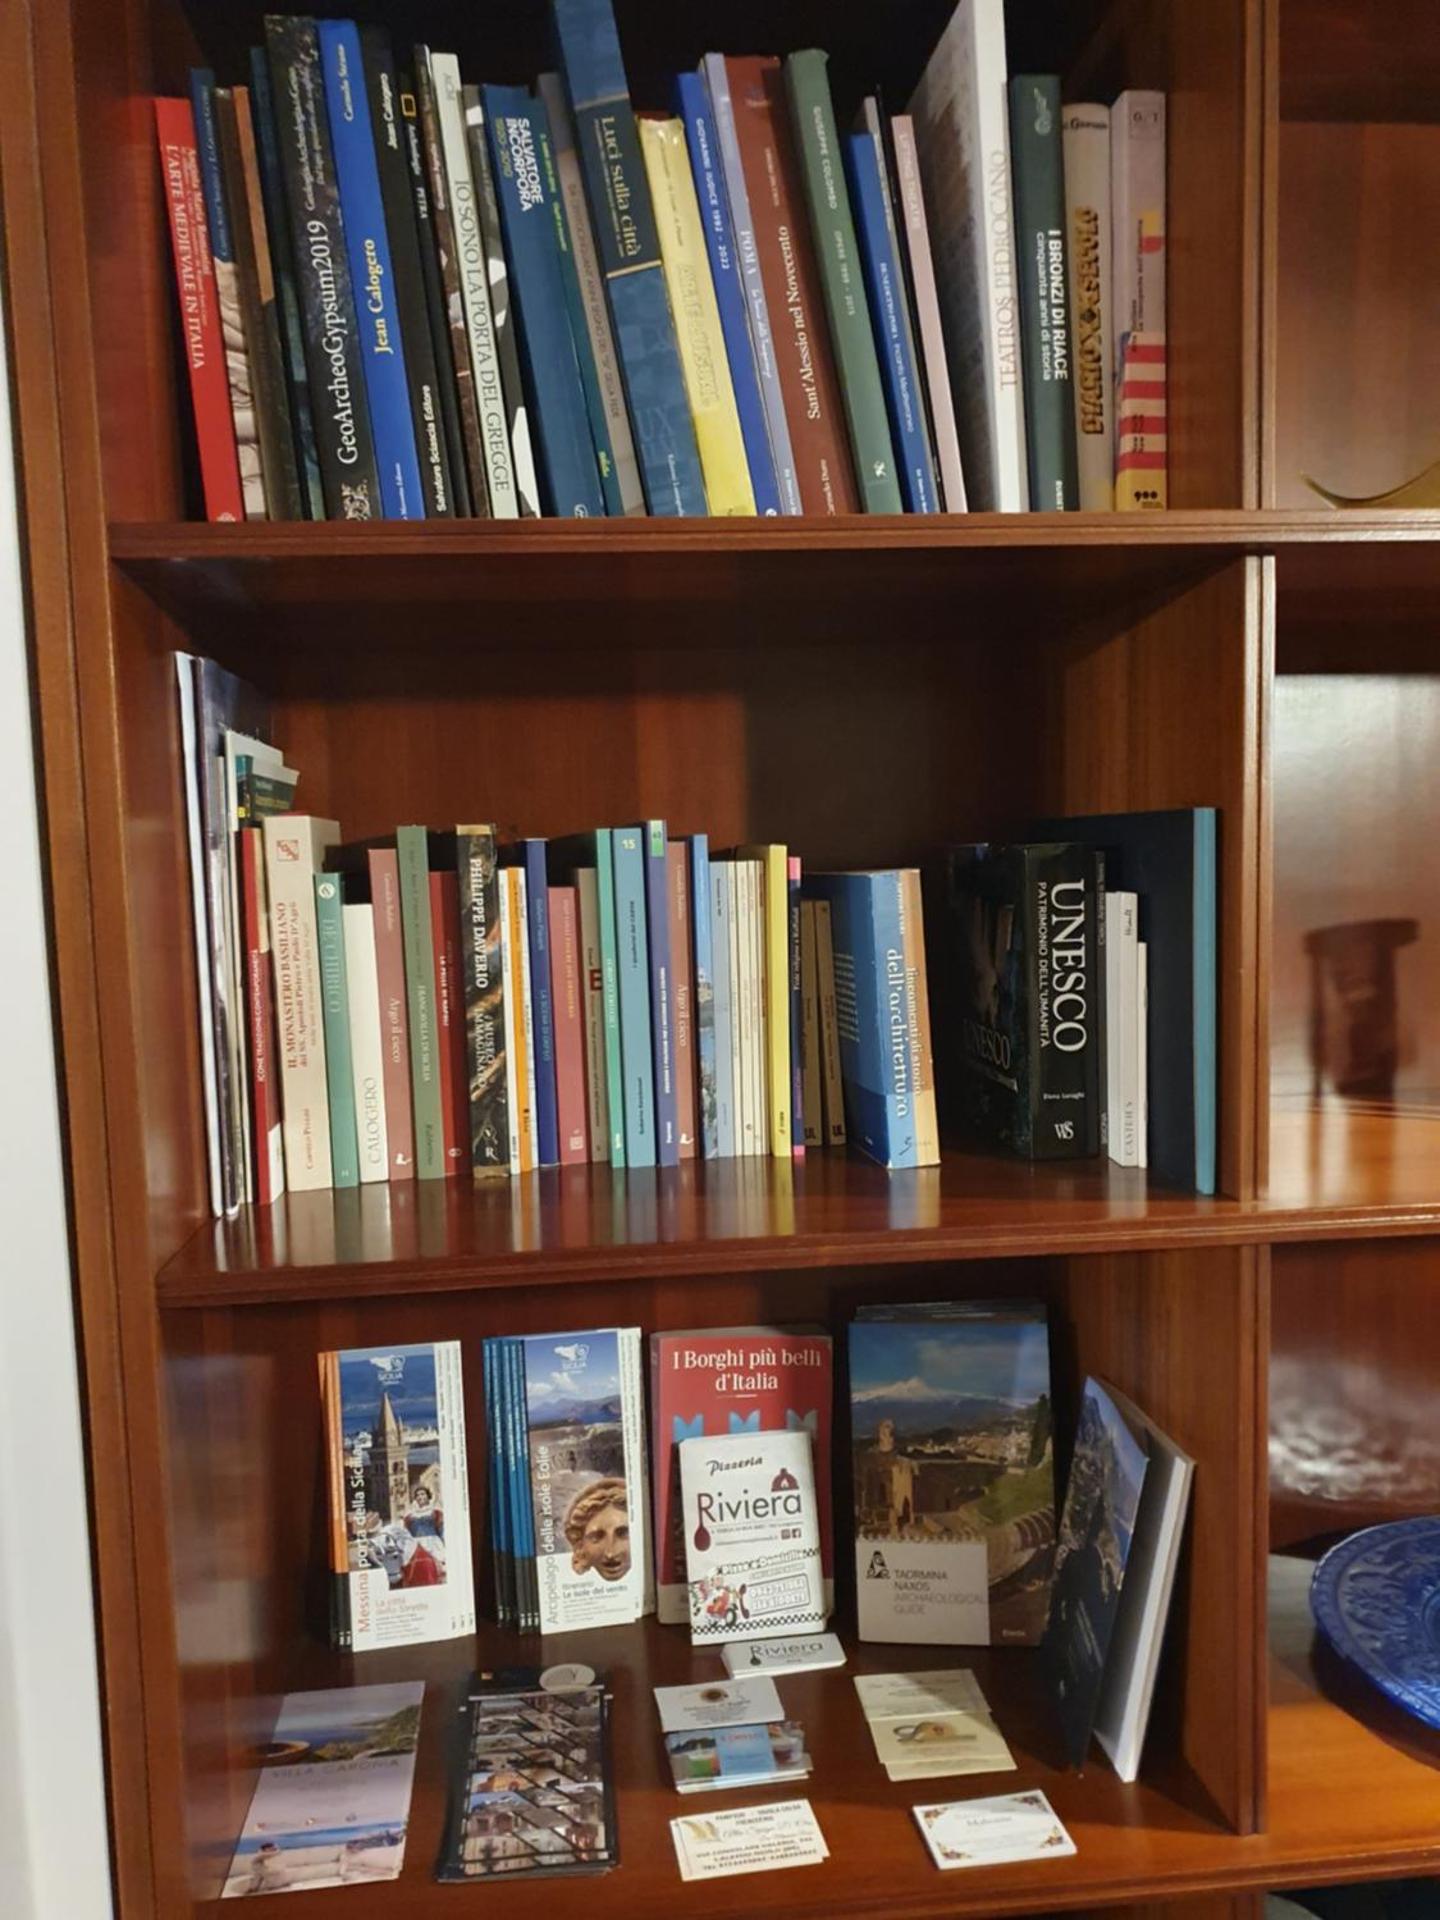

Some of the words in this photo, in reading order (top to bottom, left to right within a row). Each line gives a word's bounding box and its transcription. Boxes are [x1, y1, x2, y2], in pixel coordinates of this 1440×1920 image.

[380, 72, 394, 121] Calogero
[384, 122, 397, 150] Jean
[600, 116, 622, 160] Luci
[812, 105, 829, 156] GIUSEPPE
[166, 144, 183, 197] L'ARTE
[505, 118, 533, 211] INCORPORA
[516, 117, 544, 205] SALVATORE
[454, 178, 470, 201] IO
[609, 164, 631, 211] sulla
[695, 117, 712, 169] GIOVANNI
[705, 171, 718, 206] IUDICE
[717, 245, 730, 270] 2022
[173, 201, 195, 291] MEDIEVALE
[456, 205, 480, 265] SONO
[619, 214, 642, 257] città
[740, 229, 757, 274] POMA
[364, 238, 384, 313] Calogero
[466, 268, 484, 294] LA
[777, 225, 800, 303] Novecento
[1035, 231, 1049, 296] cinquanta
[1047, 239, 1064, 303] BRONZI
[185, 295, 198, 313] IN
[788, 306, 805, 329] nel
[1039, 298, 1050, 326] anni
[1050, 307, 1065, 325] DI
[188, 316, 205, 368] ITALIA
[306, 217, 358, 465] GeoArcheoGypsum2019
[374, 318, 392, 355] Jean
[469, 299, 494, 364] PORTA
[994, 295, 1020, 390] TEATROS
[1040, 329, 1051, 341] di
[1041, 344, 1052, 380] storia
[1051, 328, 1067, 380] RIACE
[478, 369, 499, 407] DEL
[794, 331, 821, 420] Sant'Alessio
[420, 384, 434, 420] Editore
[426, 422, 440, 463] Sciascia
[483, 411, 511, 493] GREGGE
[433, 464, 447, 512] Salvatore
[622, 838, 636, 850] 15
[469, 858, 485, 923] PHILIPPE
[275, 902, 290, 971] BASILIANO
[1037, 881, 1047, 955] PATRIMONIO
[291, 937, 300, 961] Paolo
[472, 926, 489, 988] DAVERIO
[1050, 878, 1087, 1052] UNESCO
[323, 944, 341, 1012] CHIRICO
[676, 983, 688, 1009] Argo
[280, 973, 295, 1052] MONASTERO
[387, 997, 401, 1023] Argo
[1038, 959, 1050, 1047] DELL'UMANITÀ
[474, 1008, 486, 1088] IMMAGINATO
[483, 1021, 495, 1063] MUSEO
[678, 1020, 688, 1046] cieco
[886, 948, 912, 1117] dell'architettura
[286, 1058, 296, 1069] IL
[911, 1055, 924, 1095] storia
[362, 1076, 381, 1164] CALOGERO
[672, 1352, 680, 1370] I
[684, 1350, 744, 1371] Borghi
[749, 1348, 776, 1369] più
[782, 1348, 821, 1367] belli
[715, 1374, 778, 1392] d'Italia
[349, 1447, 365, 1487] Sicilia
[536, 1445, 550, 1479] Eolie
[706, 1456, 763, 1476] Pizzeria
[351, 1490, 367, 1525] della
[538, 1483, 552, 1515] isole
[696, 1488, 802, 1523] Riviera
[355, 1527, 371, 1567] porta
[540, 1517, 555, 1552] delle
[542, 1555, 561, 1624] Arcipelago
[592, 1586, 605, 1594] del
[894, 1570, 948, 1580] TAORMINA
[894, 1581, 931, 1592] NAXOS
[356, 1572, 371, 1632] Messina
[894, 1592, 985, 1604] ARCHAEOLOGICAL
[894, 1604, 925, 1614] GUIDE
[750, 1642, 823, 1657] Riviera
